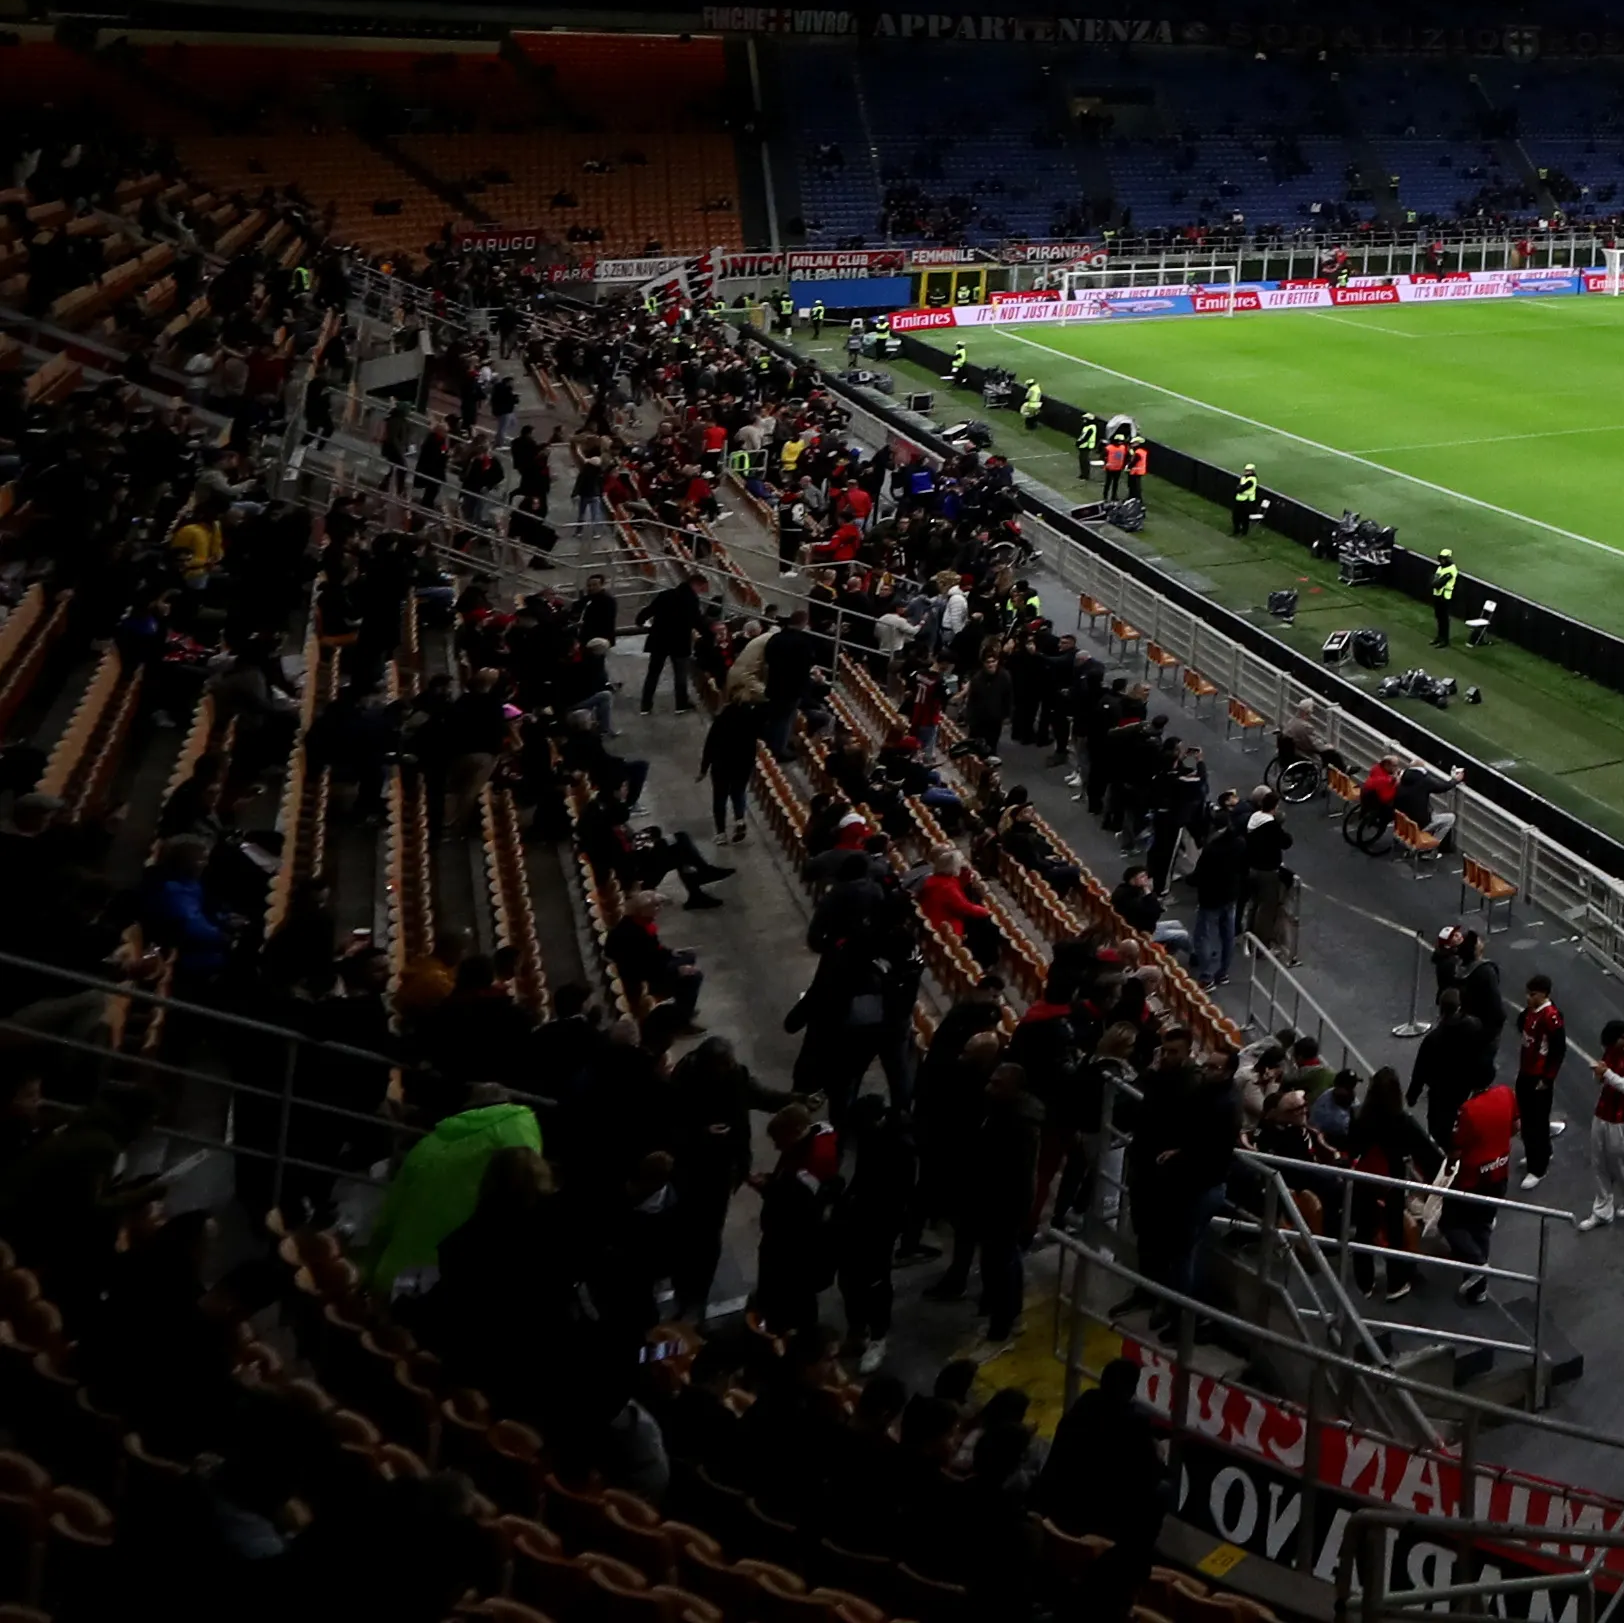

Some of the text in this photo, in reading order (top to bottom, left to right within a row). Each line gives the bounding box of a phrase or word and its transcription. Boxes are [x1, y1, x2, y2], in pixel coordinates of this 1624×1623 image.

[461, 236, 537, 253] CARUGO
[1026, 245, 1092, 260] PIRANHA
[791, 253, 869, 267] MILAN CLUB
[911, 248, 975, 264] FEMMINILE
[791, 266, 869, 282] ALBANIA
[1269, 291, 1320, 305] FLY BETTER
[1336, 288, 1394, 302] Emirates
[1413, 285, 1431, 298] IT'S
[1432, 284, 1447, 297] NOT
[1449, 283, 1472, 296] JUST
[1473, 282, 1500, 295] ABOUT
[1000, 306, 1021, 320] NOT
[1022, 304, 1049, 319] JUST
[892, 312, 952, 330] Emirates
